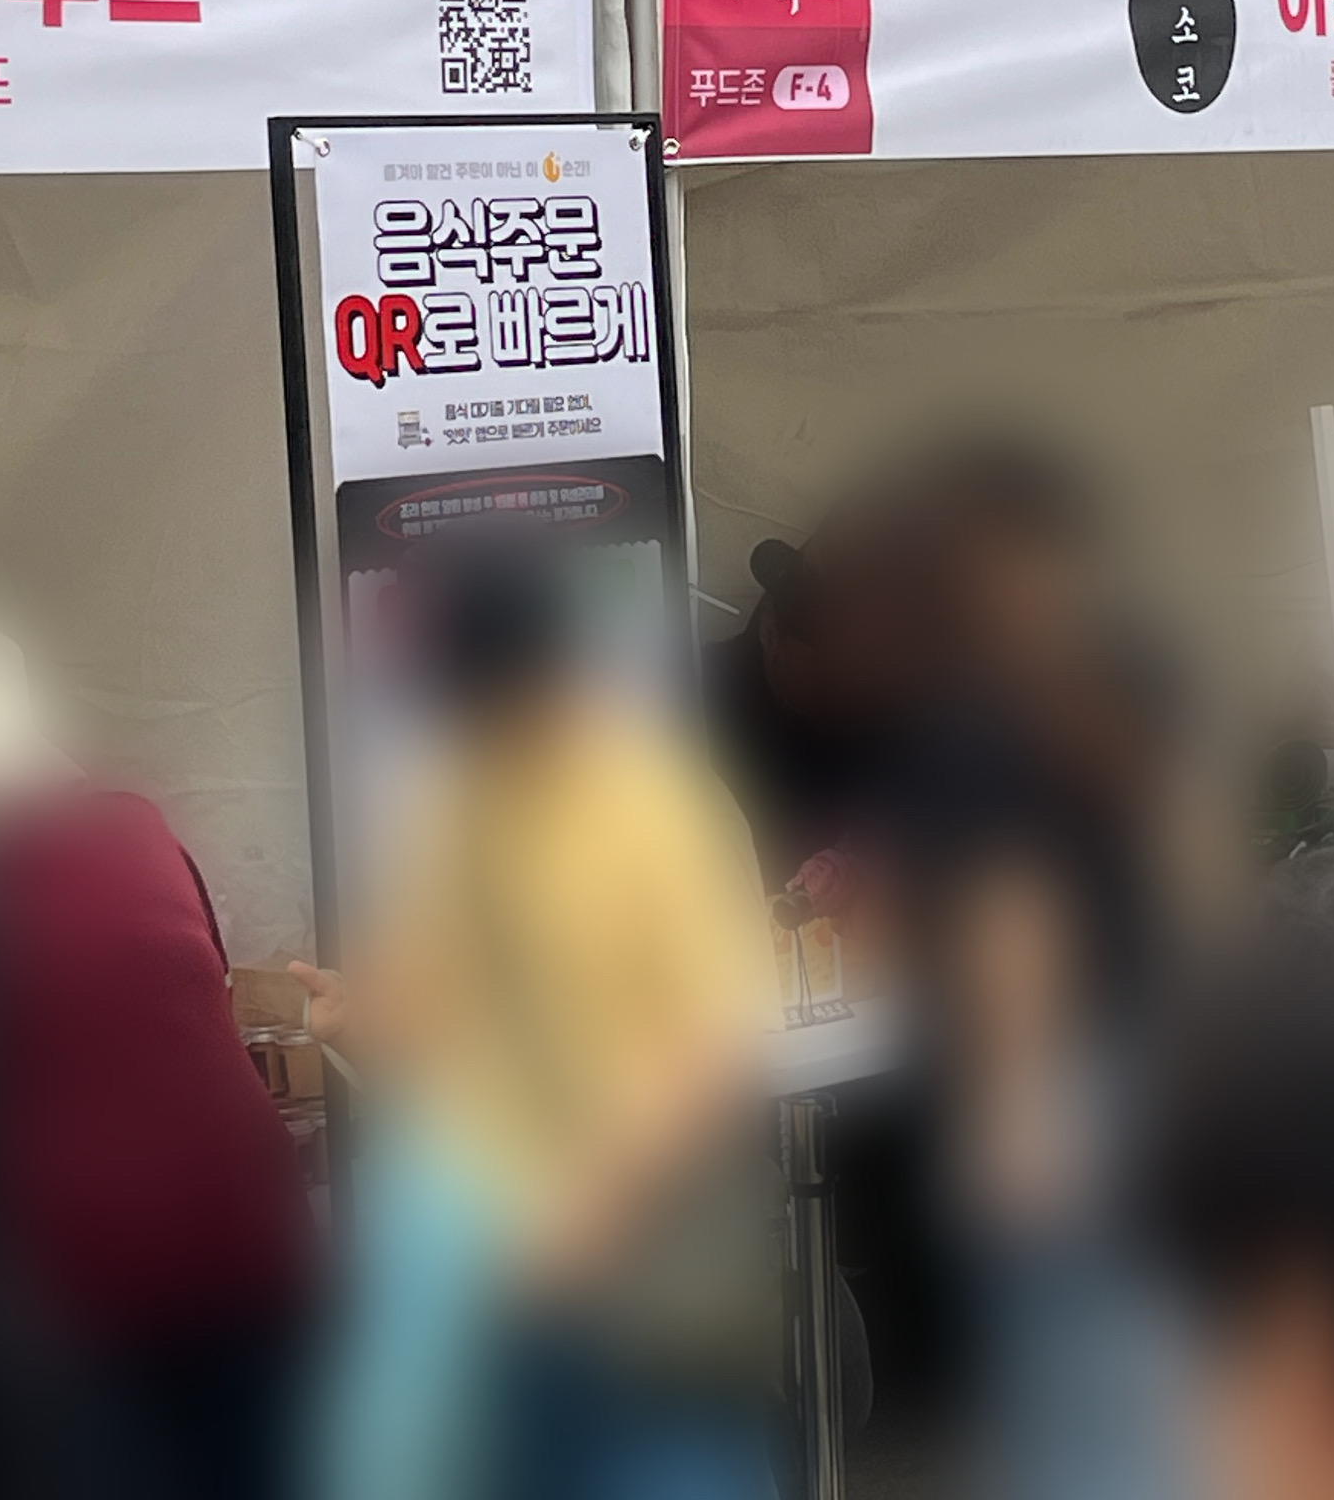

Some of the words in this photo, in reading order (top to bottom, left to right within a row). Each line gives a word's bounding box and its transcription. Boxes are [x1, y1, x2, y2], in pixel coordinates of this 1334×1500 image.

[690, 69, 766, 107] 푸드존
[789, 73, 832, 102] F-4
[372, 196, 603, 286] 음식주문
[334, 291, 483, 389] QR로
[487, 280, 651, 369] 빠르게
